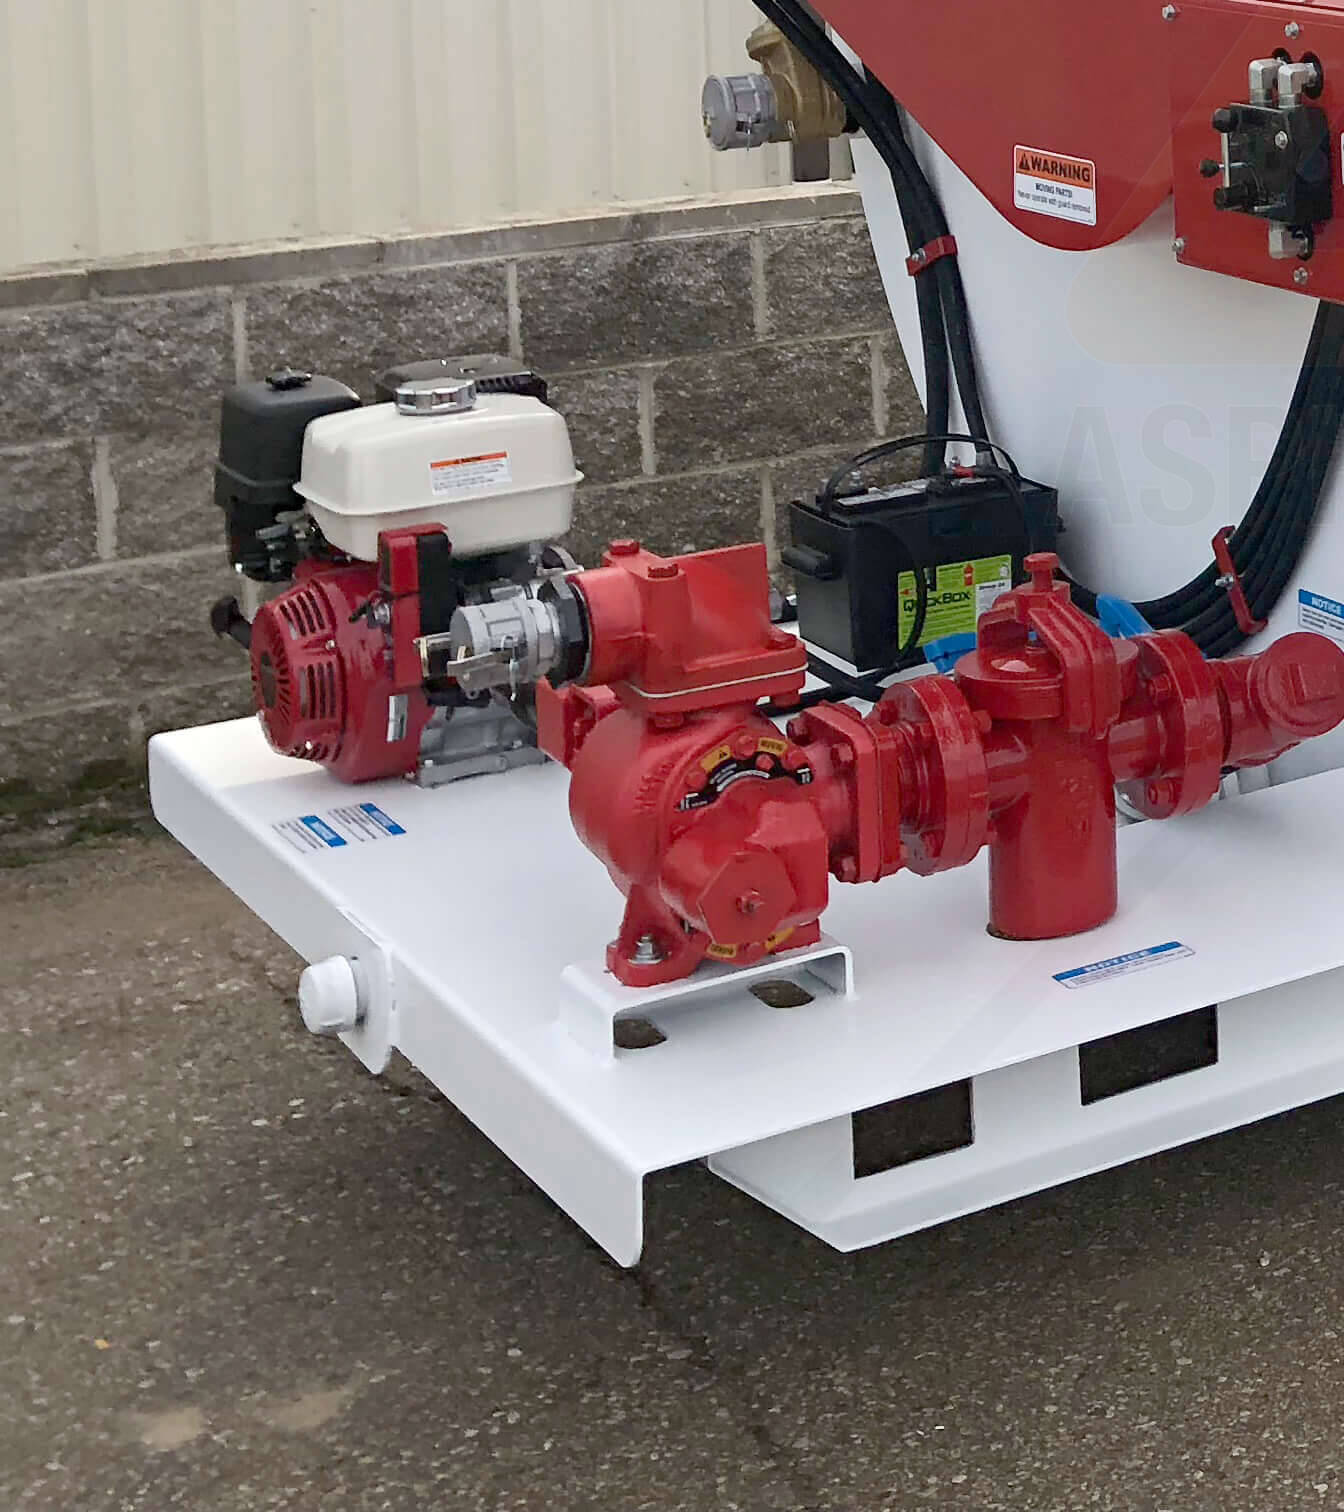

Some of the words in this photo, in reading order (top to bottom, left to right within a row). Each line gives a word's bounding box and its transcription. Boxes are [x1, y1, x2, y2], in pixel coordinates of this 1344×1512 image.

[1031, 155, 1091, 183] WARNING
[1311, 596, 1342, 615] NOTICE
[1084, 950, 1152, 972] NOTICE
